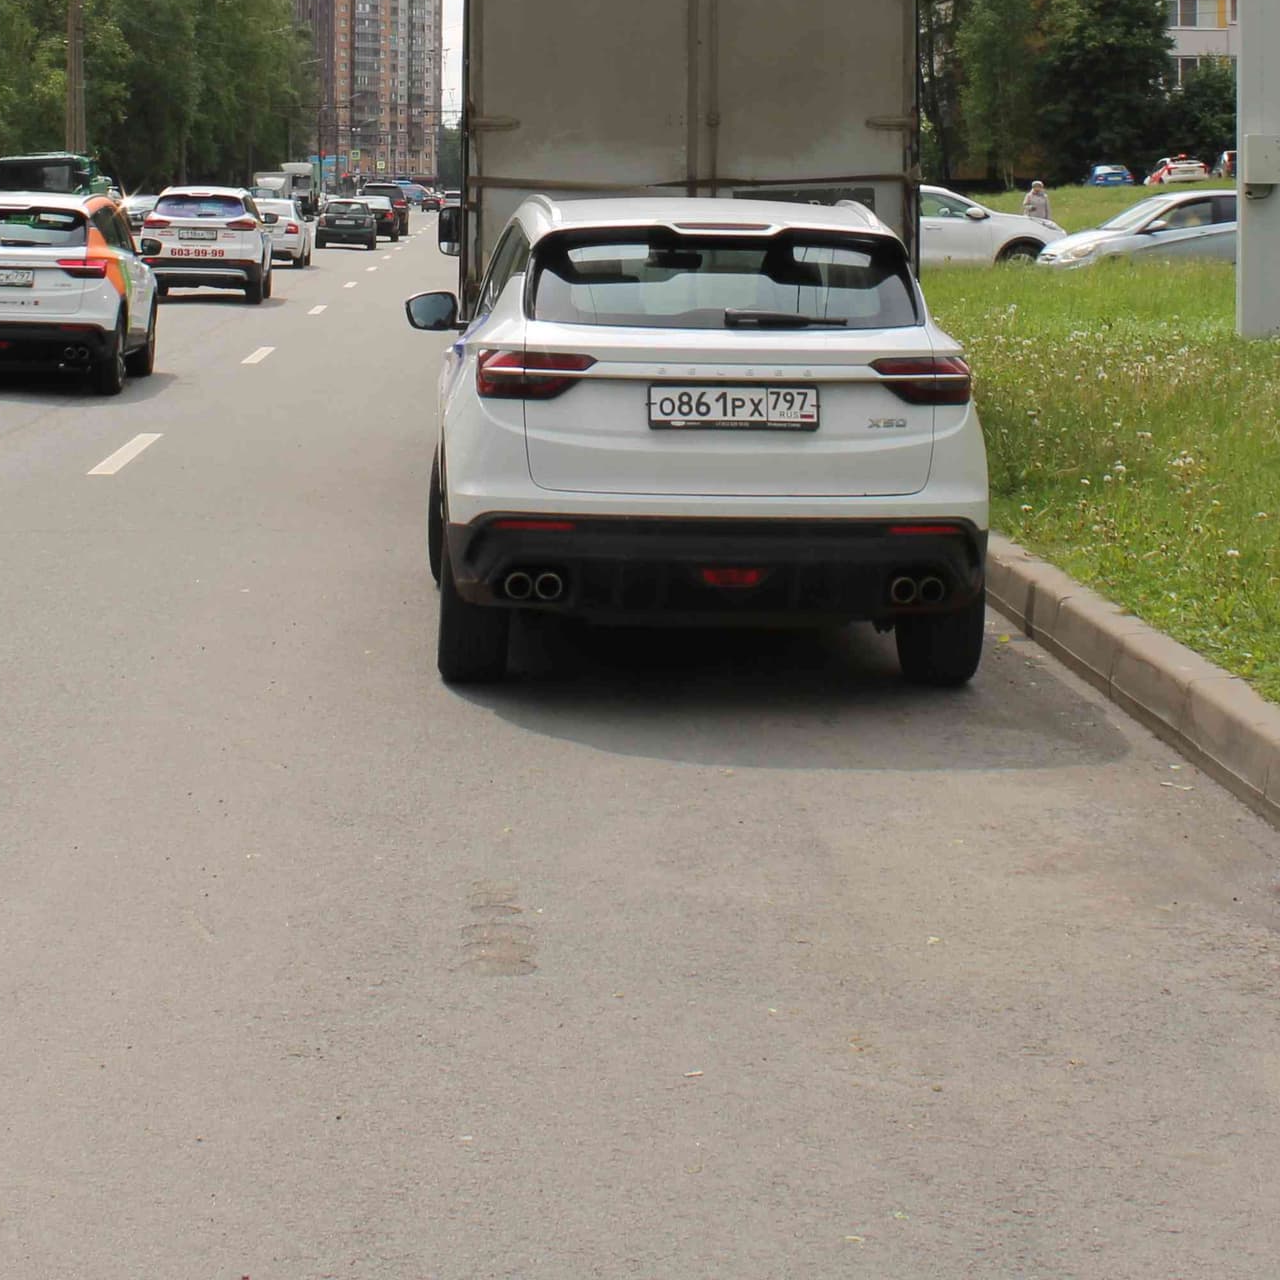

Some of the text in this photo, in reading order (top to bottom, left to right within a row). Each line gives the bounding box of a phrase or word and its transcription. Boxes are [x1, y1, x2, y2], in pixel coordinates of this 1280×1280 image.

[170, 247, 225, 257] 603-99-99
[769, 391, 809, 411] 797
[779, 410, 800, 419] RUS
